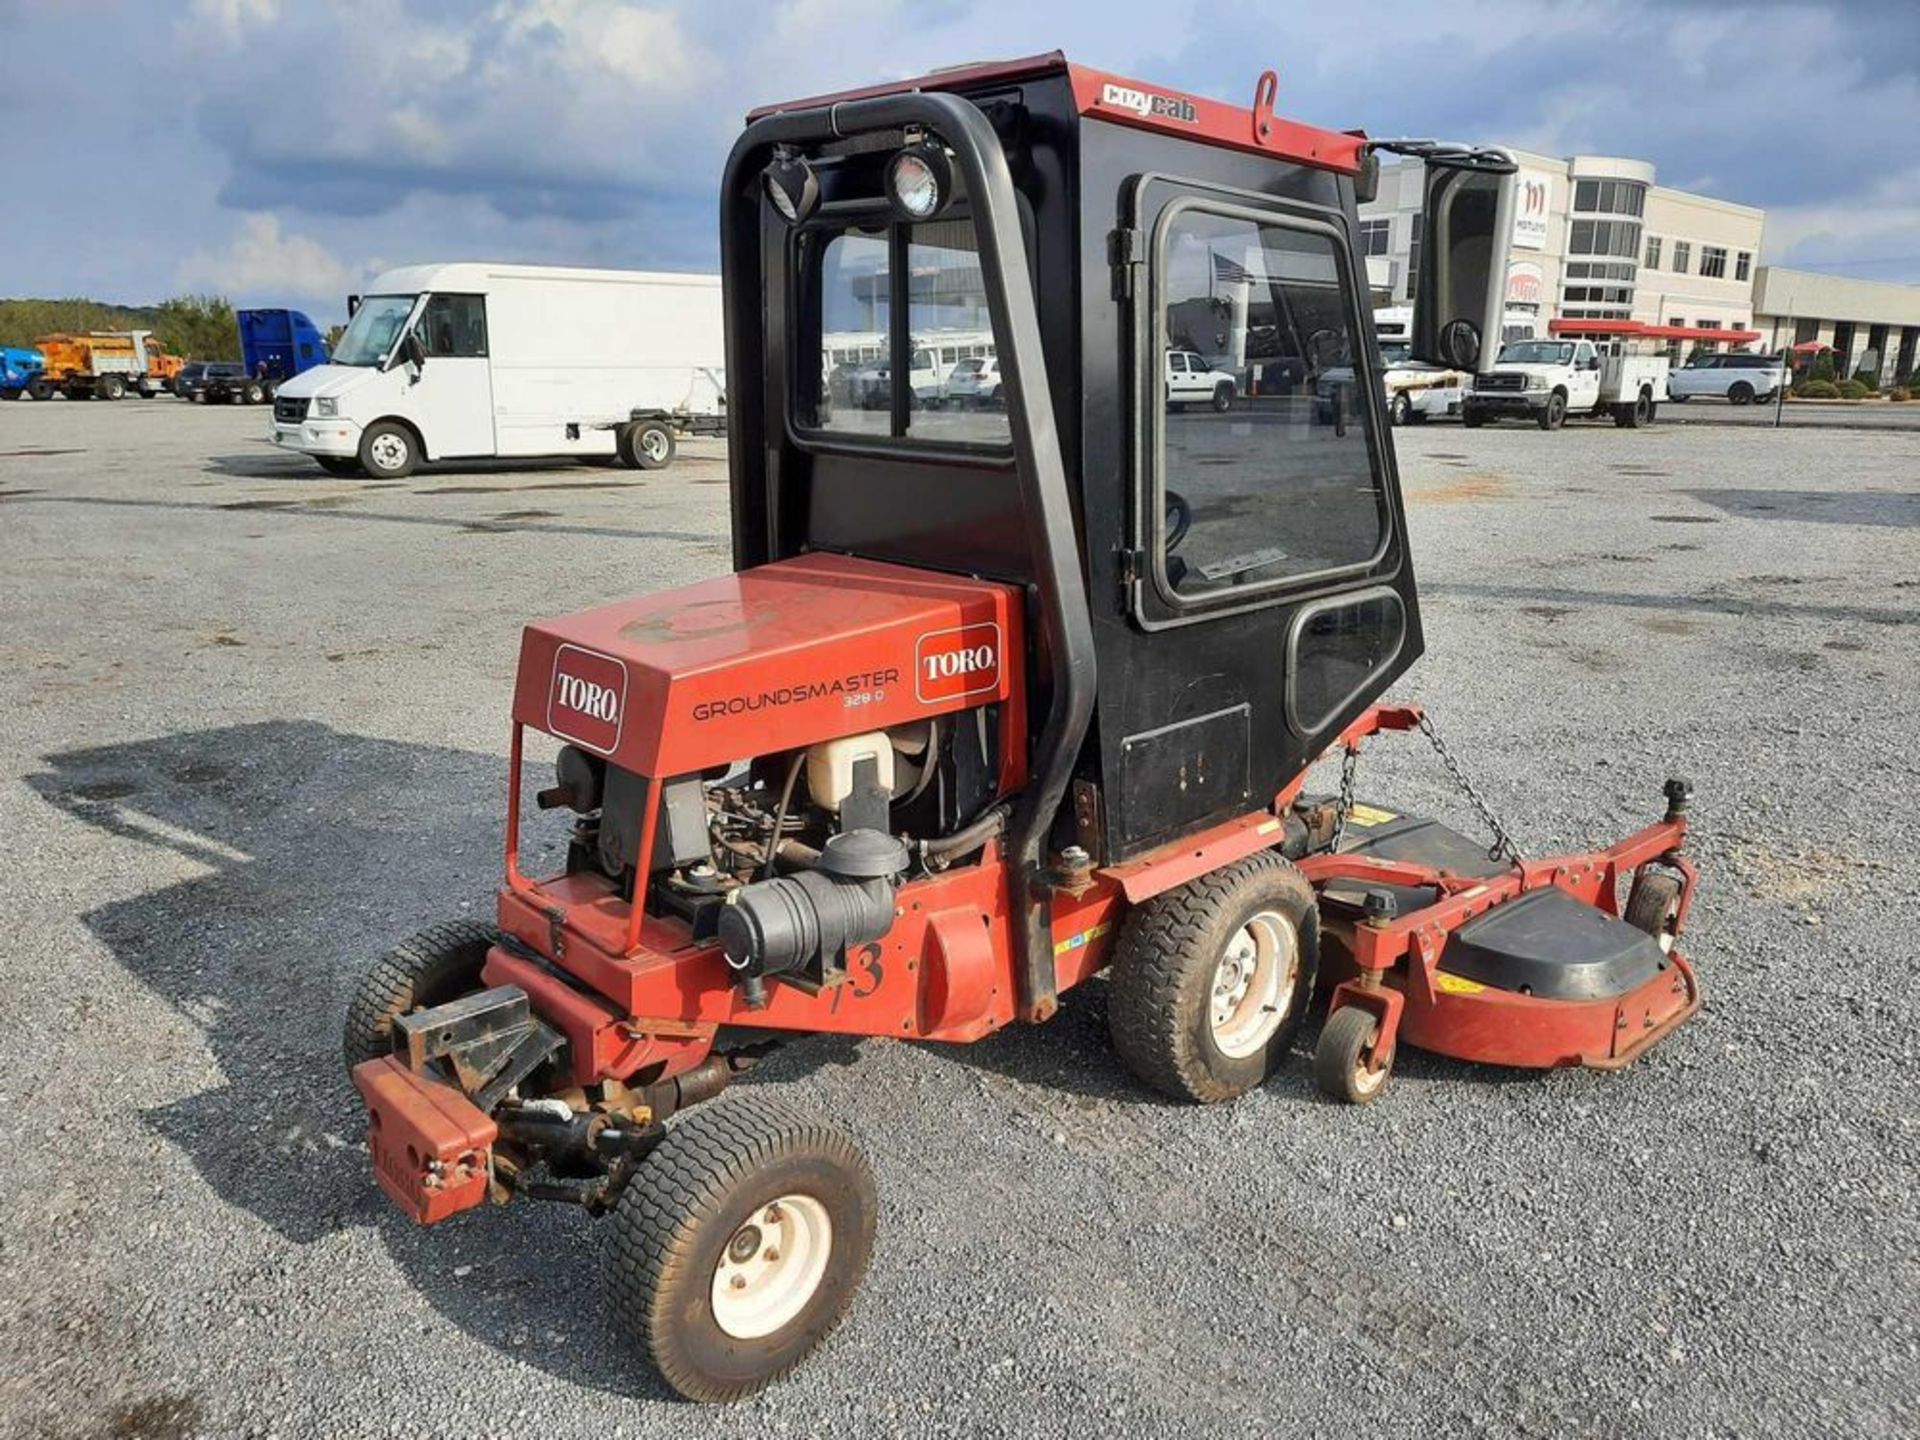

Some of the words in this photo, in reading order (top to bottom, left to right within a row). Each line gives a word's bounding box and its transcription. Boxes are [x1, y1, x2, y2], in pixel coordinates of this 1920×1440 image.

[923, 645, 993, 680] TORO
[558, 673, 618, 722] TORO
[692, 668, 899, 721] GROUNDSMASTER
